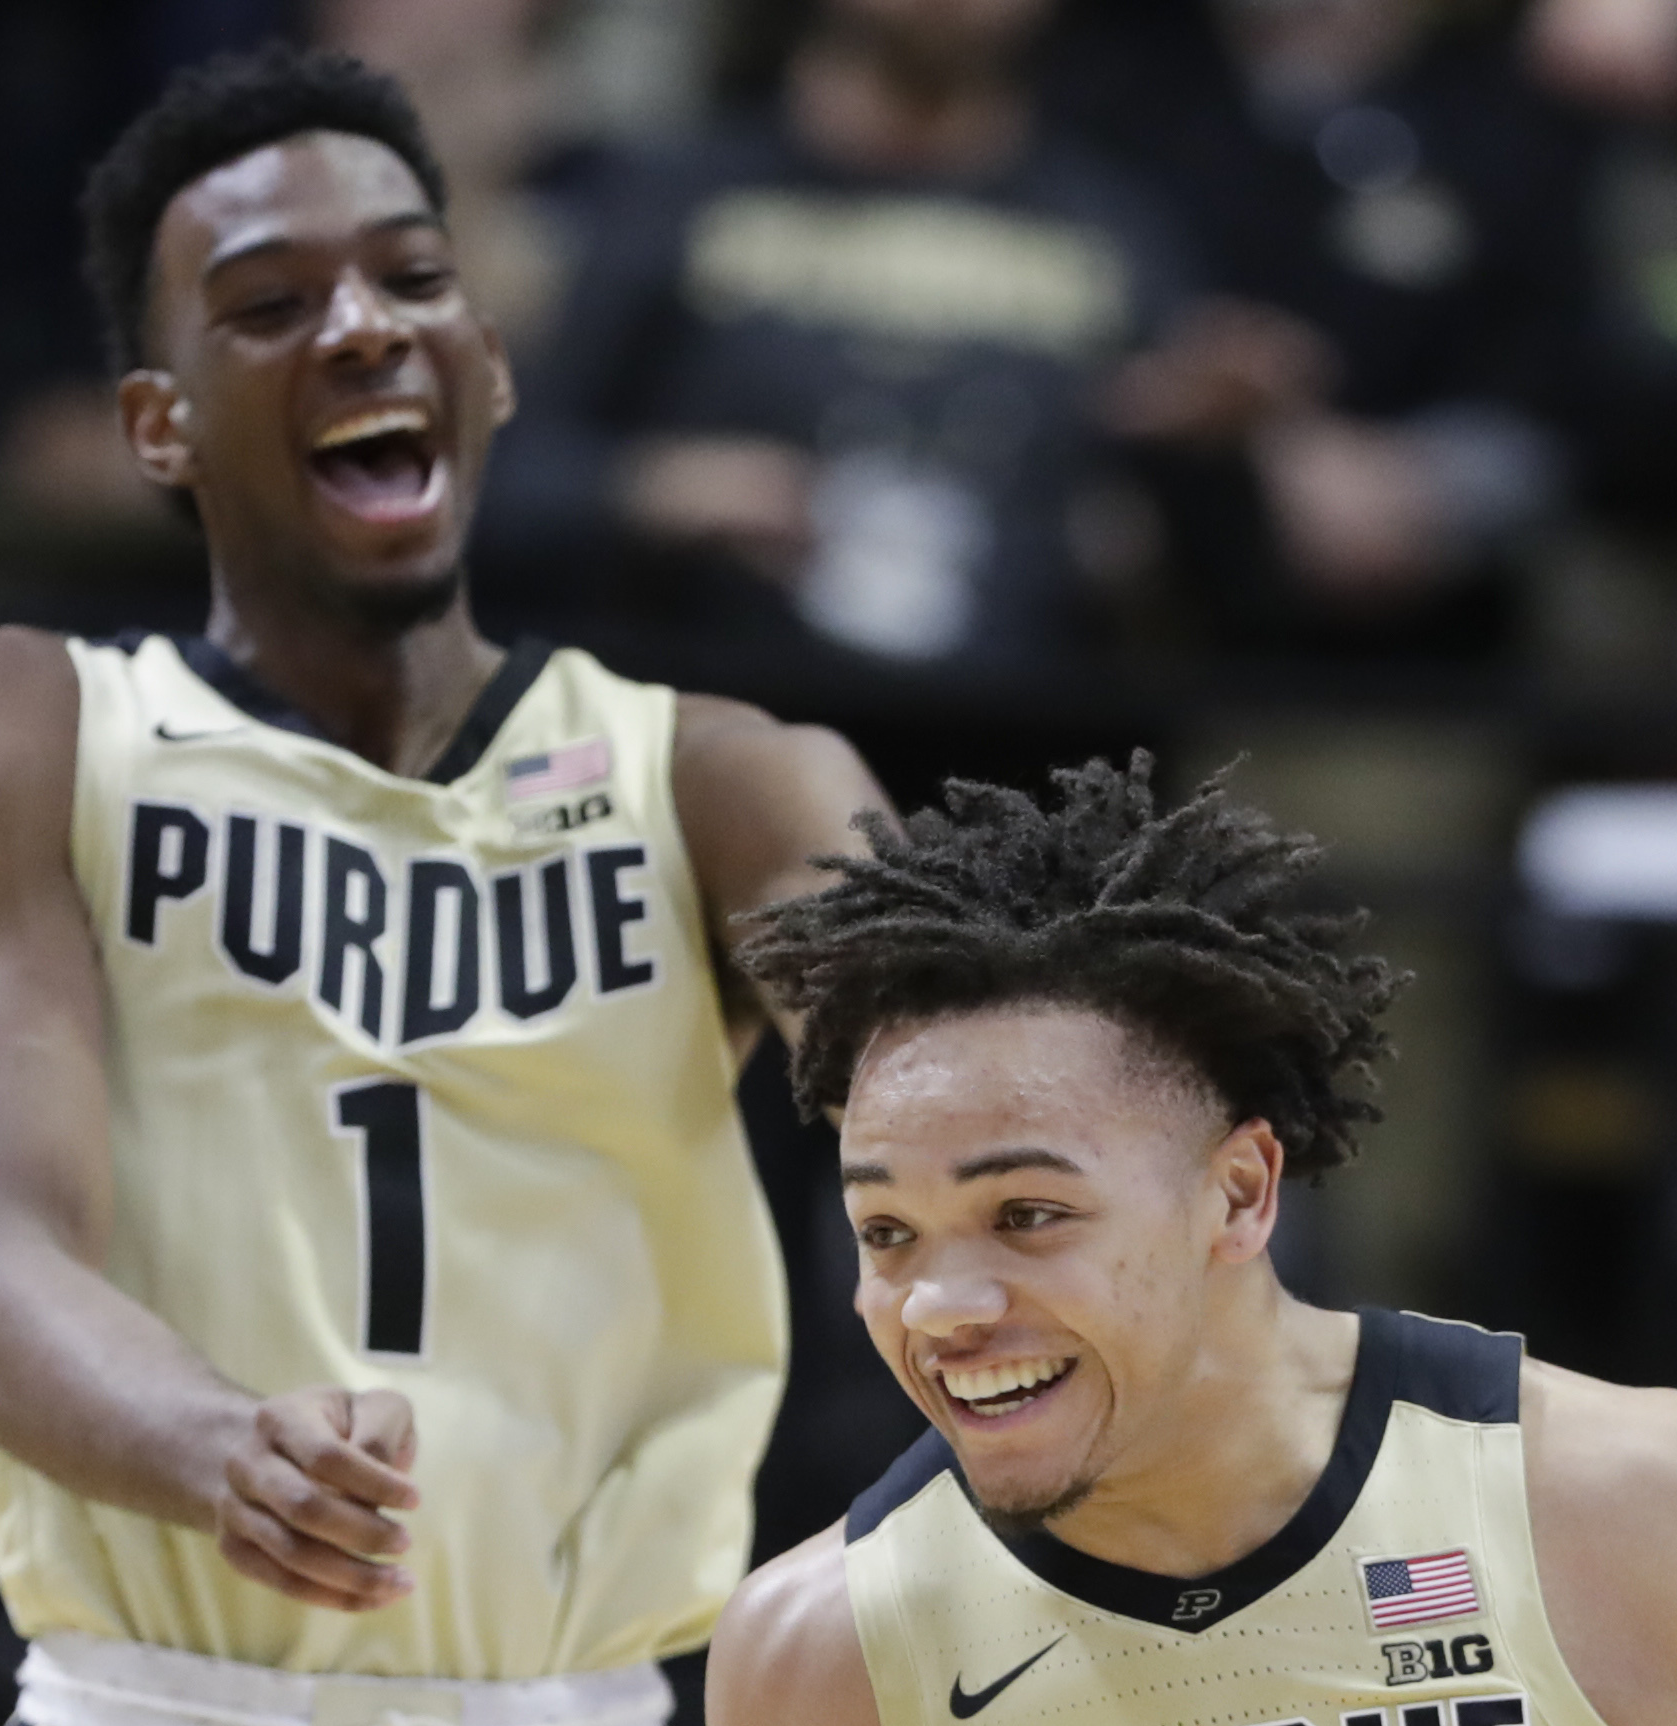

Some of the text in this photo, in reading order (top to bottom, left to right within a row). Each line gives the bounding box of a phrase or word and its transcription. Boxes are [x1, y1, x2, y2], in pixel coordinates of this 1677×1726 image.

[124, 799, 659, 1053] PURDUE
[329, 1076, 426, 1359] 1
[1171, 1588, 1221, 1622] P
